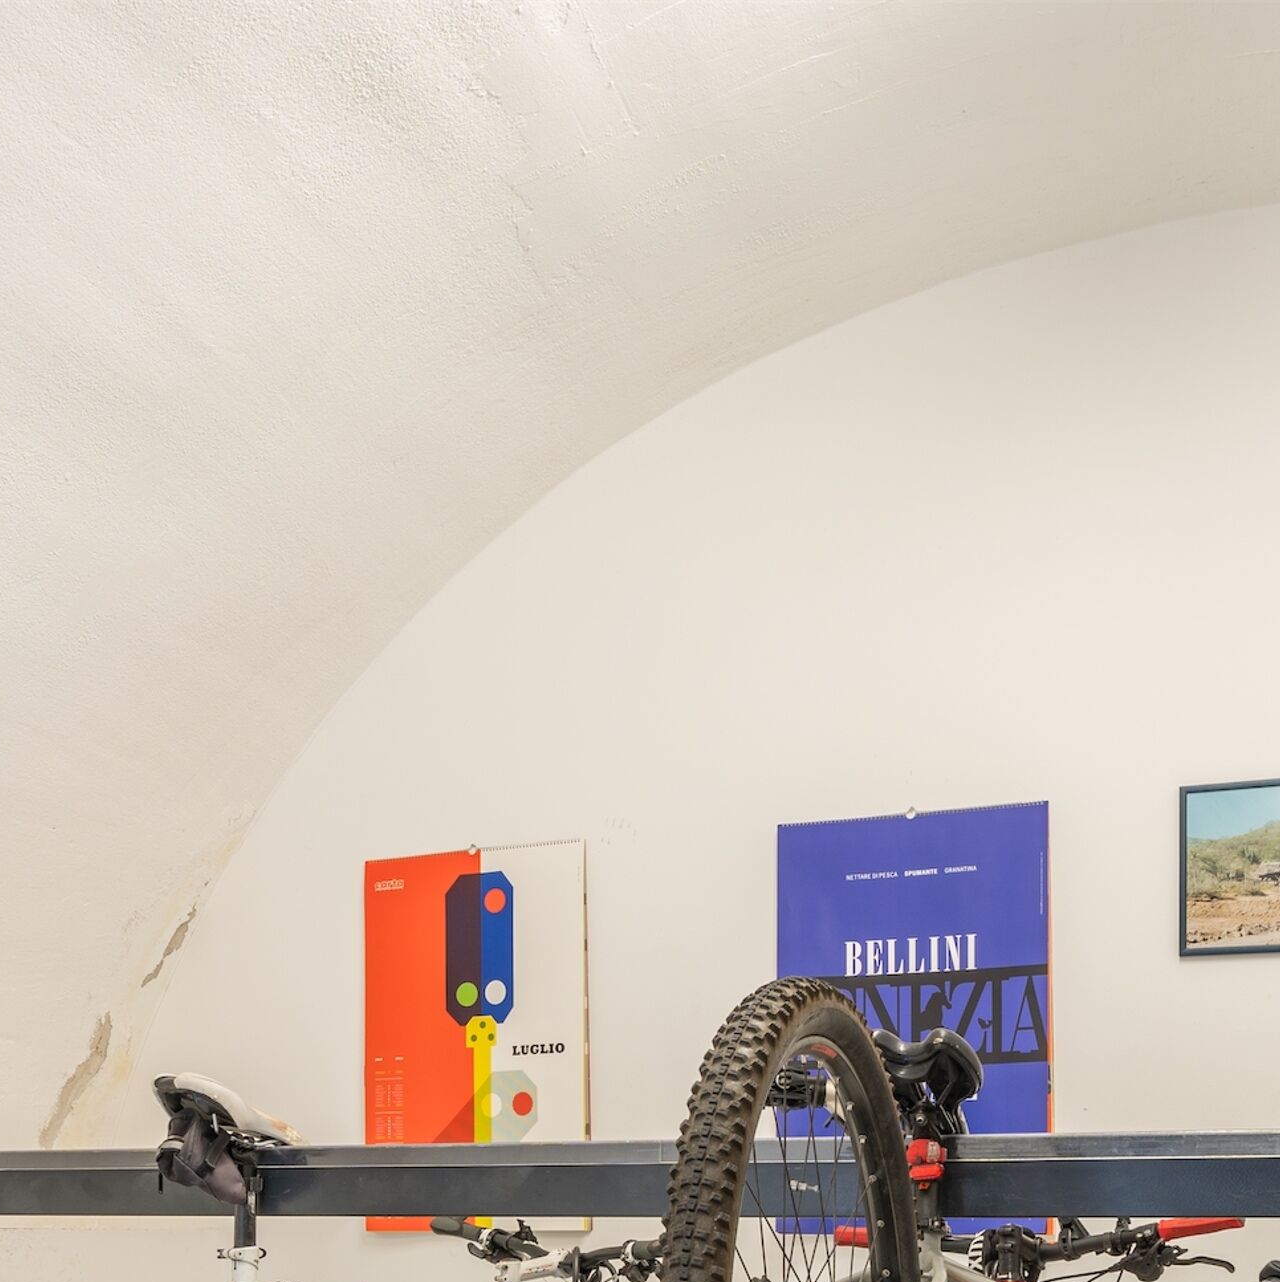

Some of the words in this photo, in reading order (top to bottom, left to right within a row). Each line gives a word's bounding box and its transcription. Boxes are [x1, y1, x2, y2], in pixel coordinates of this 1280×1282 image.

[845, 872, 871, 881] NETTARE
[878, 871, 899, 880] PESCA
[904, 868, 938, 877] SPUMANTE
[944, 864, 978, 874] GRANATINA
[844, 933, 978, 978] BELLINI
[512, 1042, 565, 1056] LUGLIO
